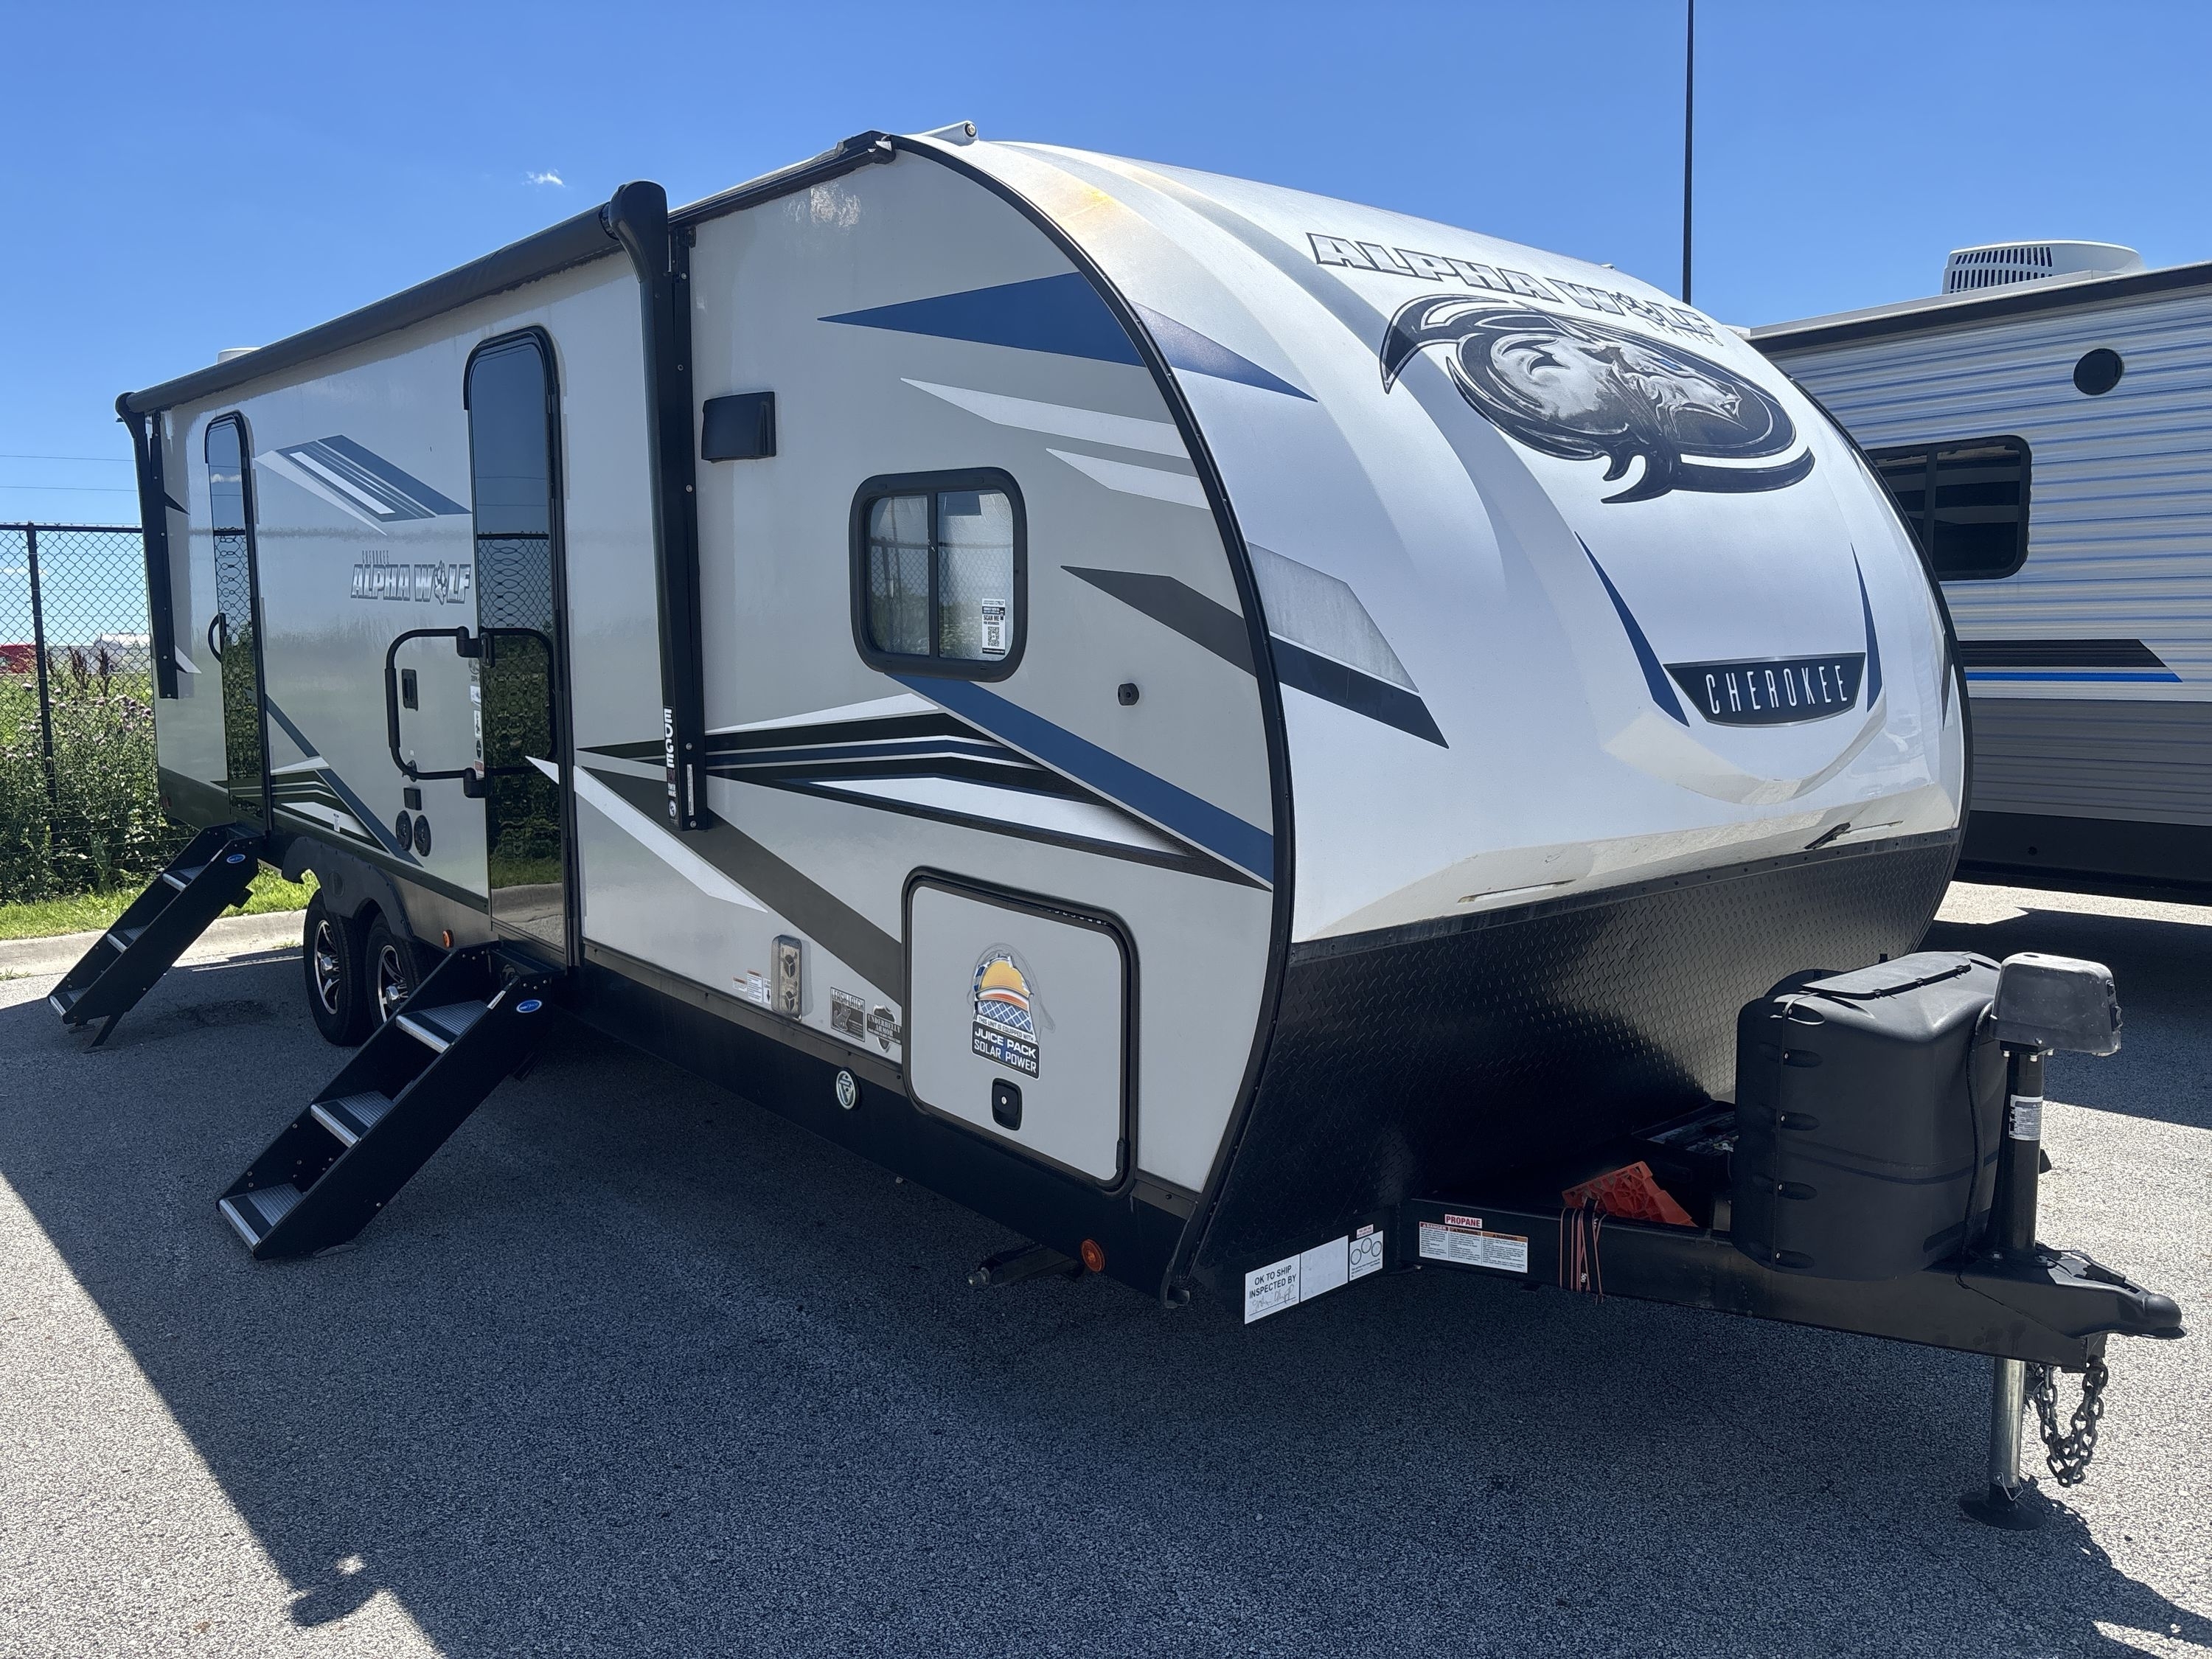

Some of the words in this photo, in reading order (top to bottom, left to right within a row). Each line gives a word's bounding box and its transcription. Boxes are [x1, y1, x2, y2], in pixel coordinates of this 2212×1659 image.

[1307, 232, 1563, 304] ALPHA
[350, 563, 411, 601] ALPHA
[1705, 664, 1848, 714] CHEROKEE
[868, 1015, 900, 1033] UNDERBELLY
[875, 1025, 894, 1037] ARMOR
[978, 1017, 987, 1025] THIS
[1002, 1026, 1023, 1037] EQUIPPED
[1023, 1034, 1034, 1042] WITH
[975, 1028, 1004, 1046] JUICE
[1006, 1038, 1037, 1059] PACK
[974, 1039, 1001, 1059] SOLAR
[1005, 1051, 1037, 1074] POWER
[1446, 1216, 1481, 1227] PROPANE
[1249, 1278, 1286, 1298] INSPECTED
[1287, 1274, 1297, 1284] BY
[1254, 1275, 1265, 1285] OK
[1266, 1271, 1276, 1281] TO
[1276, 1265, 1292, 1277] SHIP
